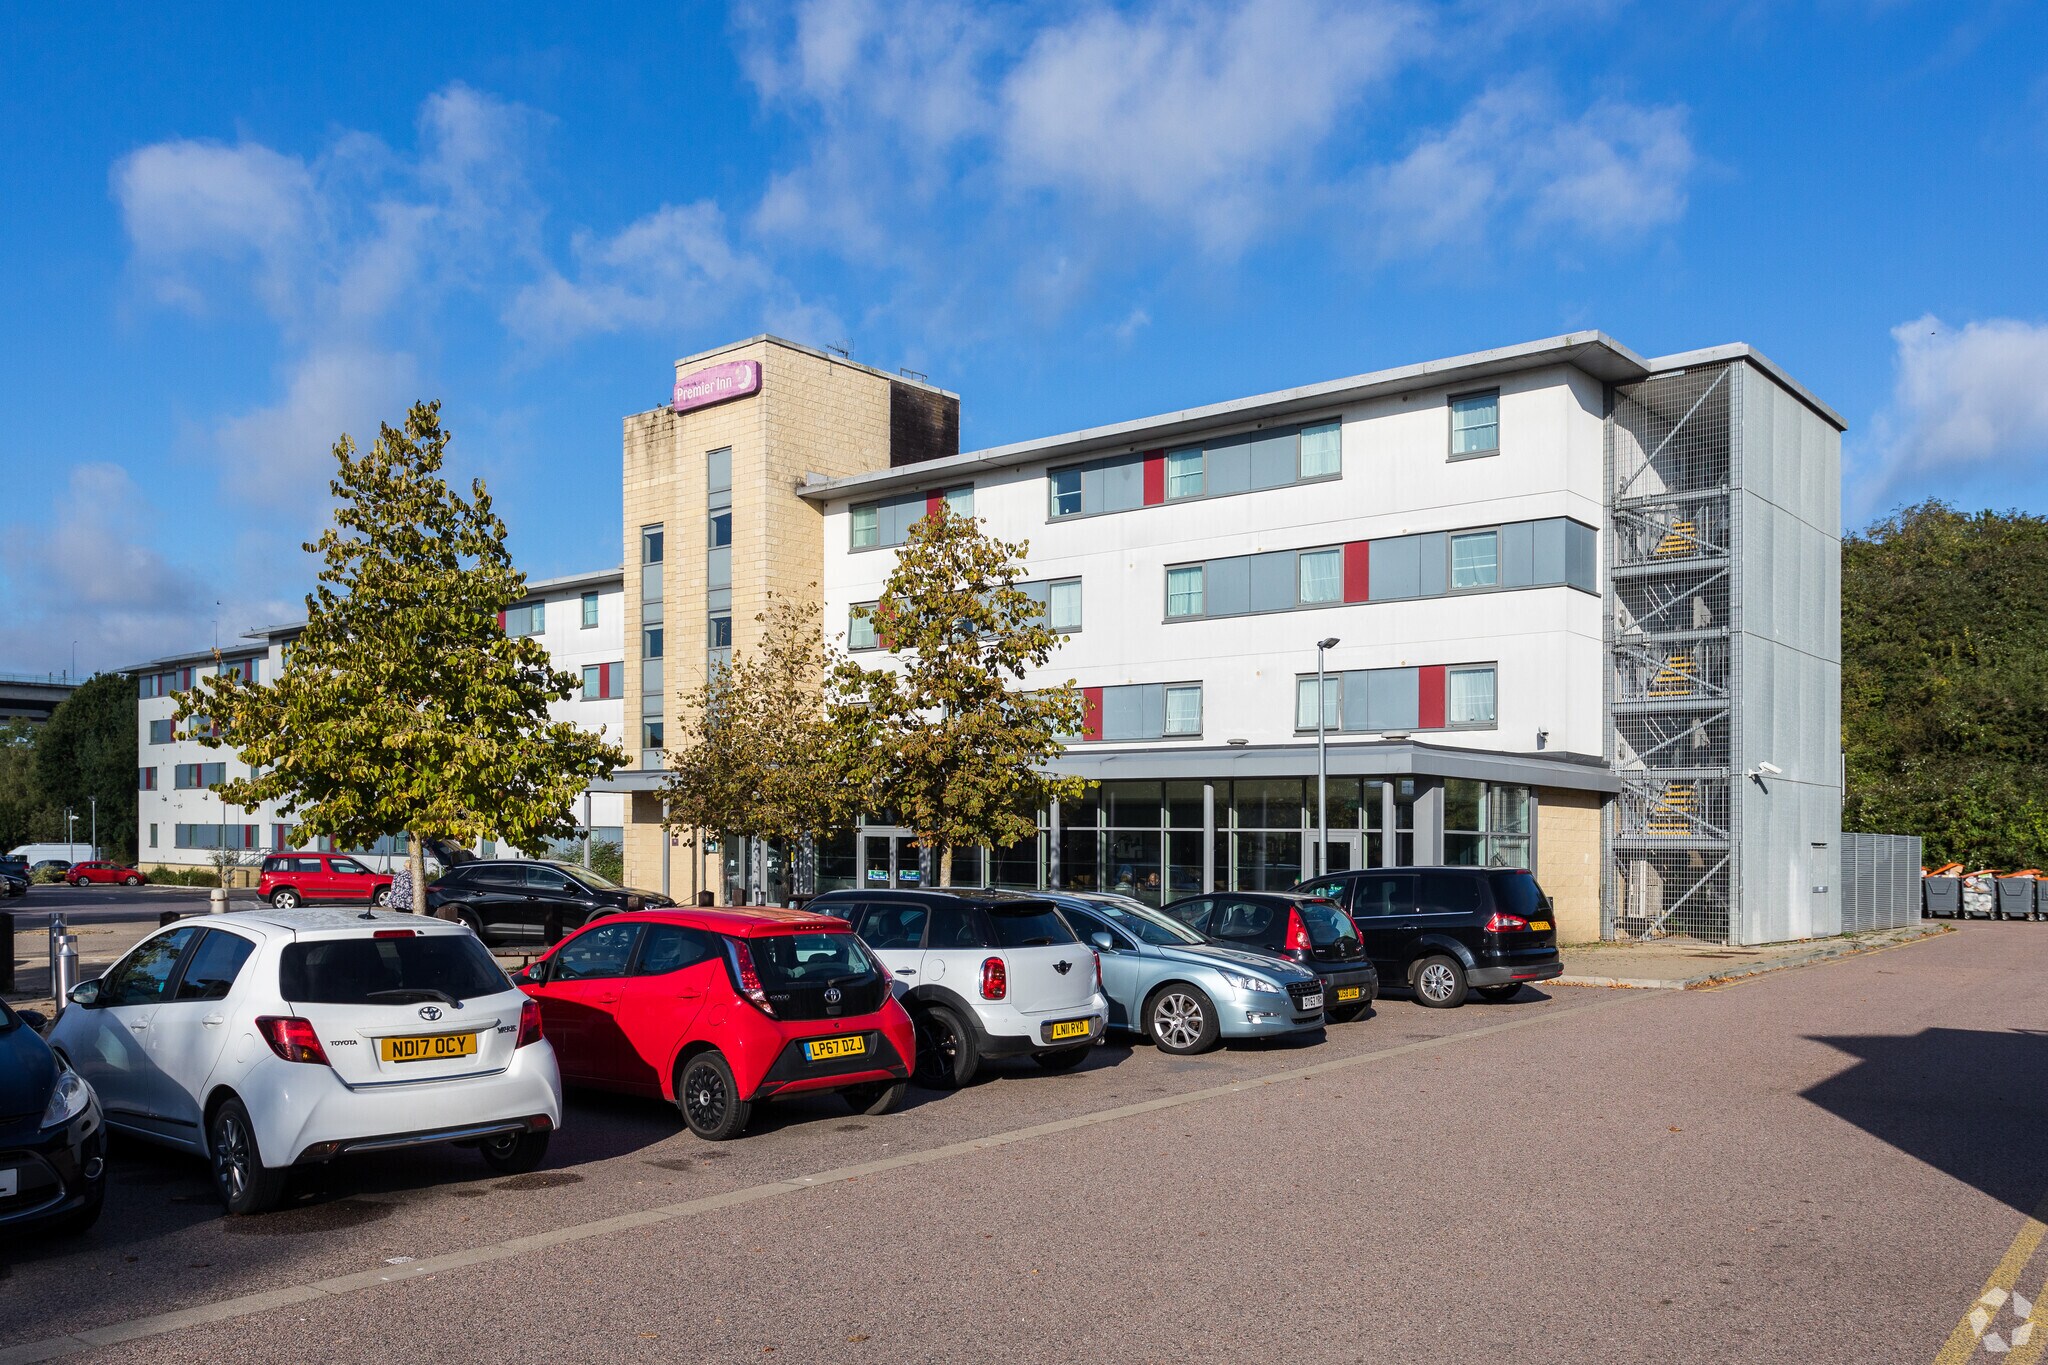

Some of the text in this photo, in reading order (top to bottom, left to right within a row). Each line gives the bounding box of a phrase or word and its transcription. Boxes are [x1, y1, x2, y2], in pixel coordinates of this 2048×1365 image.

[677, 377, 732, 402] Premier Inn
[1056, 1021, 1085, 1036] LN11 RYD
[392, 1036, 467, 1058] ND17 OCY
[811, 1037, 863, 1056] LP67 DZJ
